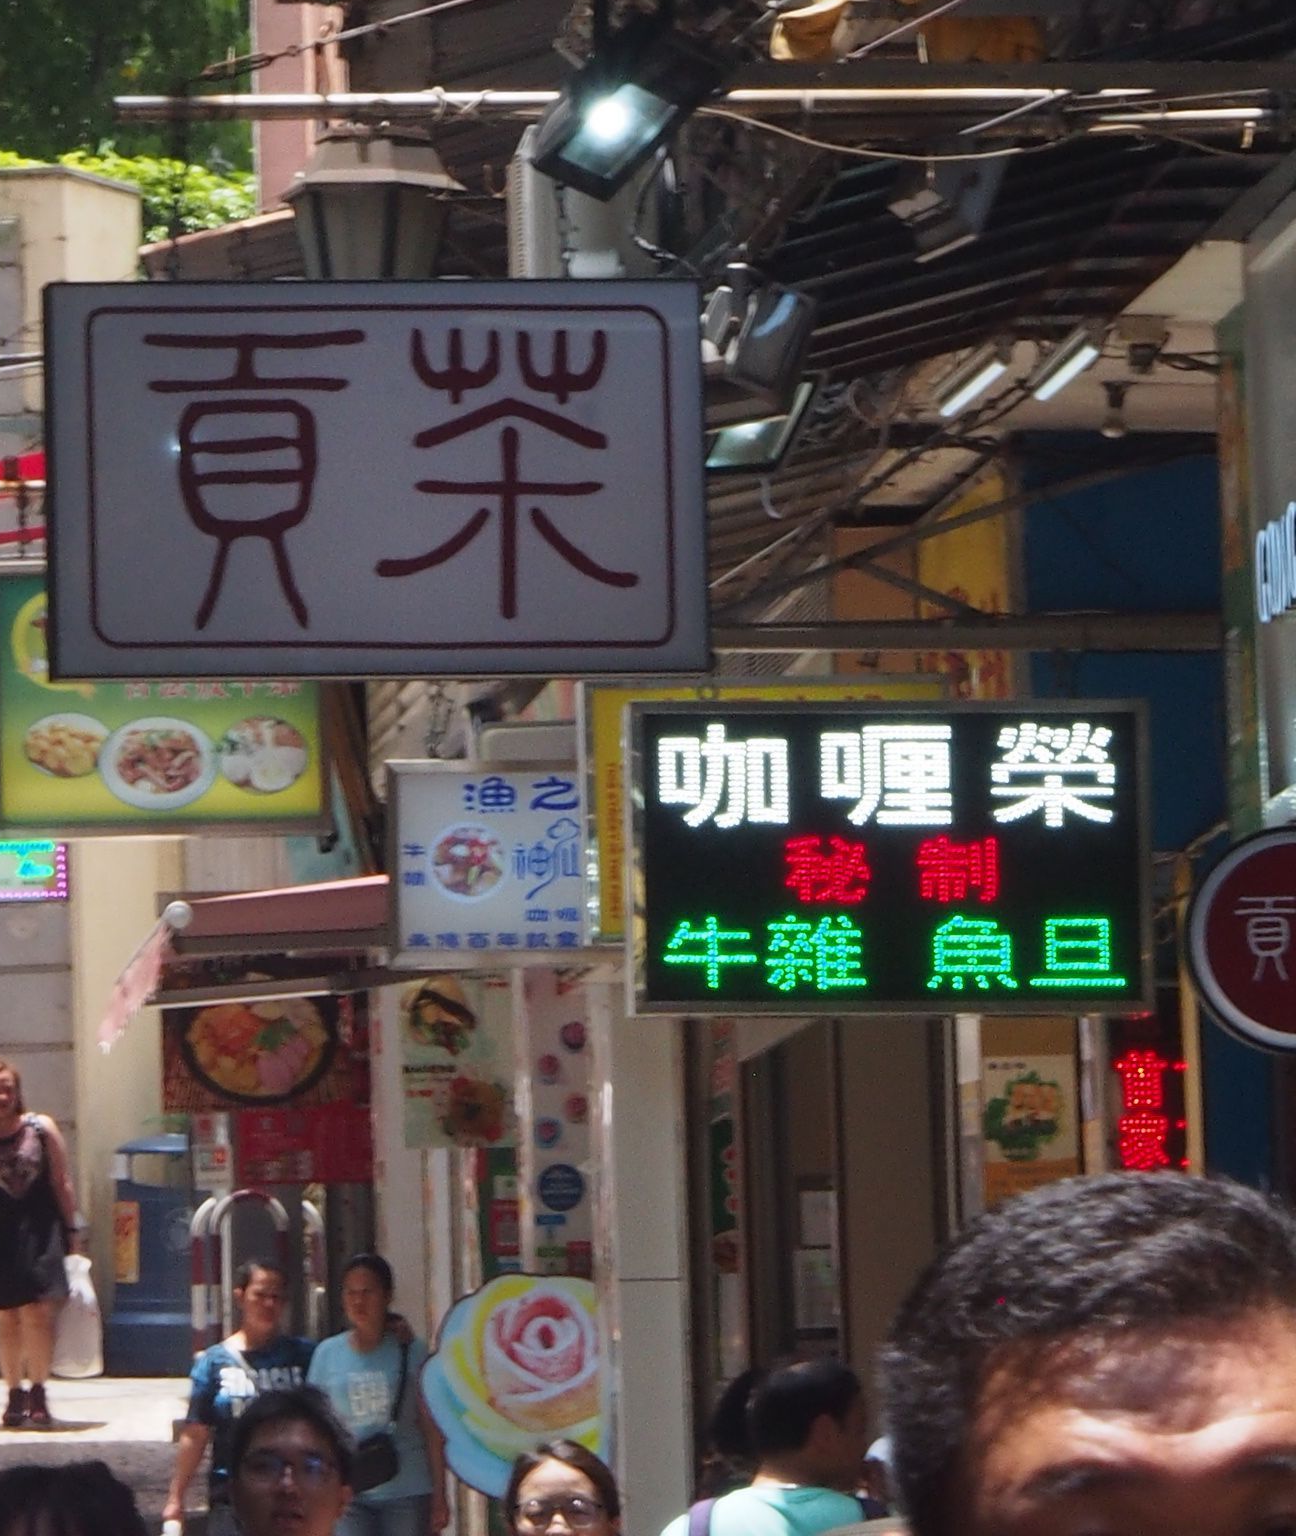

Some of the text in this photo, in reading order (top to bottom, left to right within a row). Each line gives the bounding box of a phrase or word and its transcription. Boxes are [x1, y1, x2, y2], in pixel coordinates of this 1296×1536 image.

[142, 328, 640, 631] 貢茶
[657, 723, 1116, 828] 咖喱榮
[784, 835, 999, 904] 秘制
[664, 915, 1127, 990] 牛雜 魚旦
